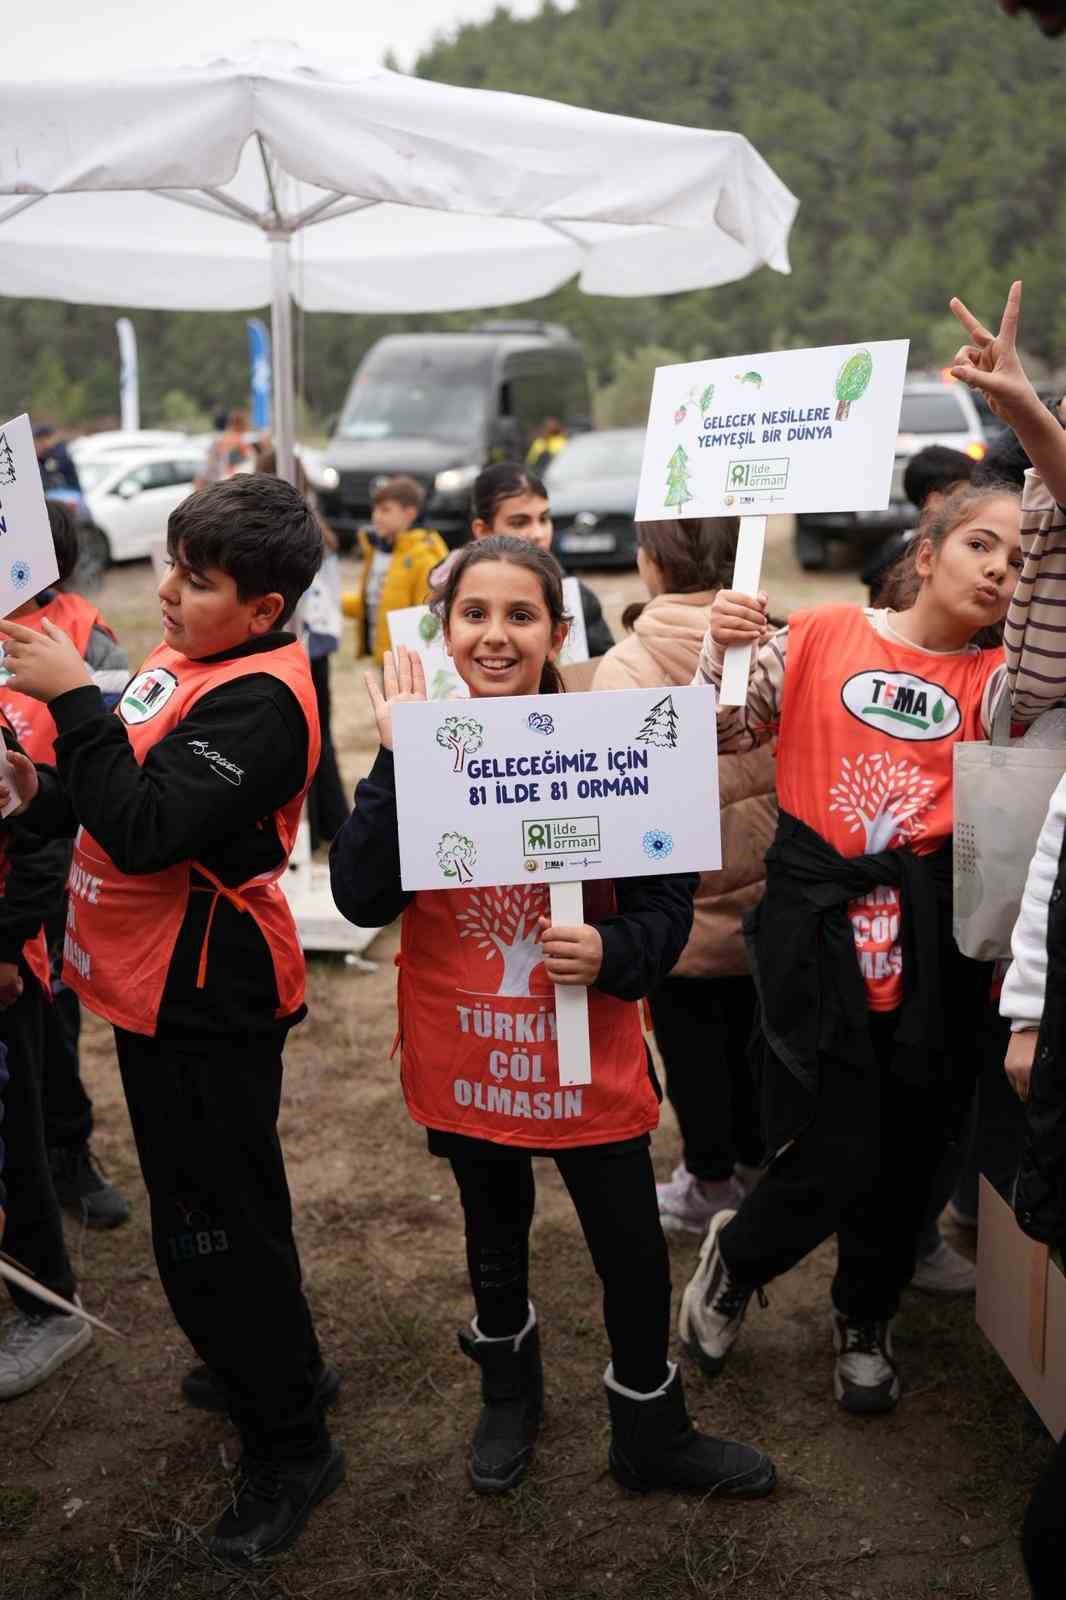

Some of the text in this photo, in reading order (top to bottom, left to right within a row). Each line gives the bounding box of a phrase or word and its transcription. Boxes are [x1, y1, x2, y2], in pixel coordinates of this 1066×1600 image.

[704, 407, 831, 430] GELECEK NESİLLERE
[698, 424, 832, 449] YEMYEŞİL BİR DÜNYA
[872, 679, 927, 717] TEMA
[467, 746, 648, 779] GELECEĞİMİZ İÇİN
[469, 776, 648, 805] 81 İLDE 81 ORMAN
[553, 823, 577, 835] ilde
[553, 838, 596, 849] orman
[489, 1048, 546, 1083] ÇÖL
[453, 1079, 583, 1120] OLMASIN
